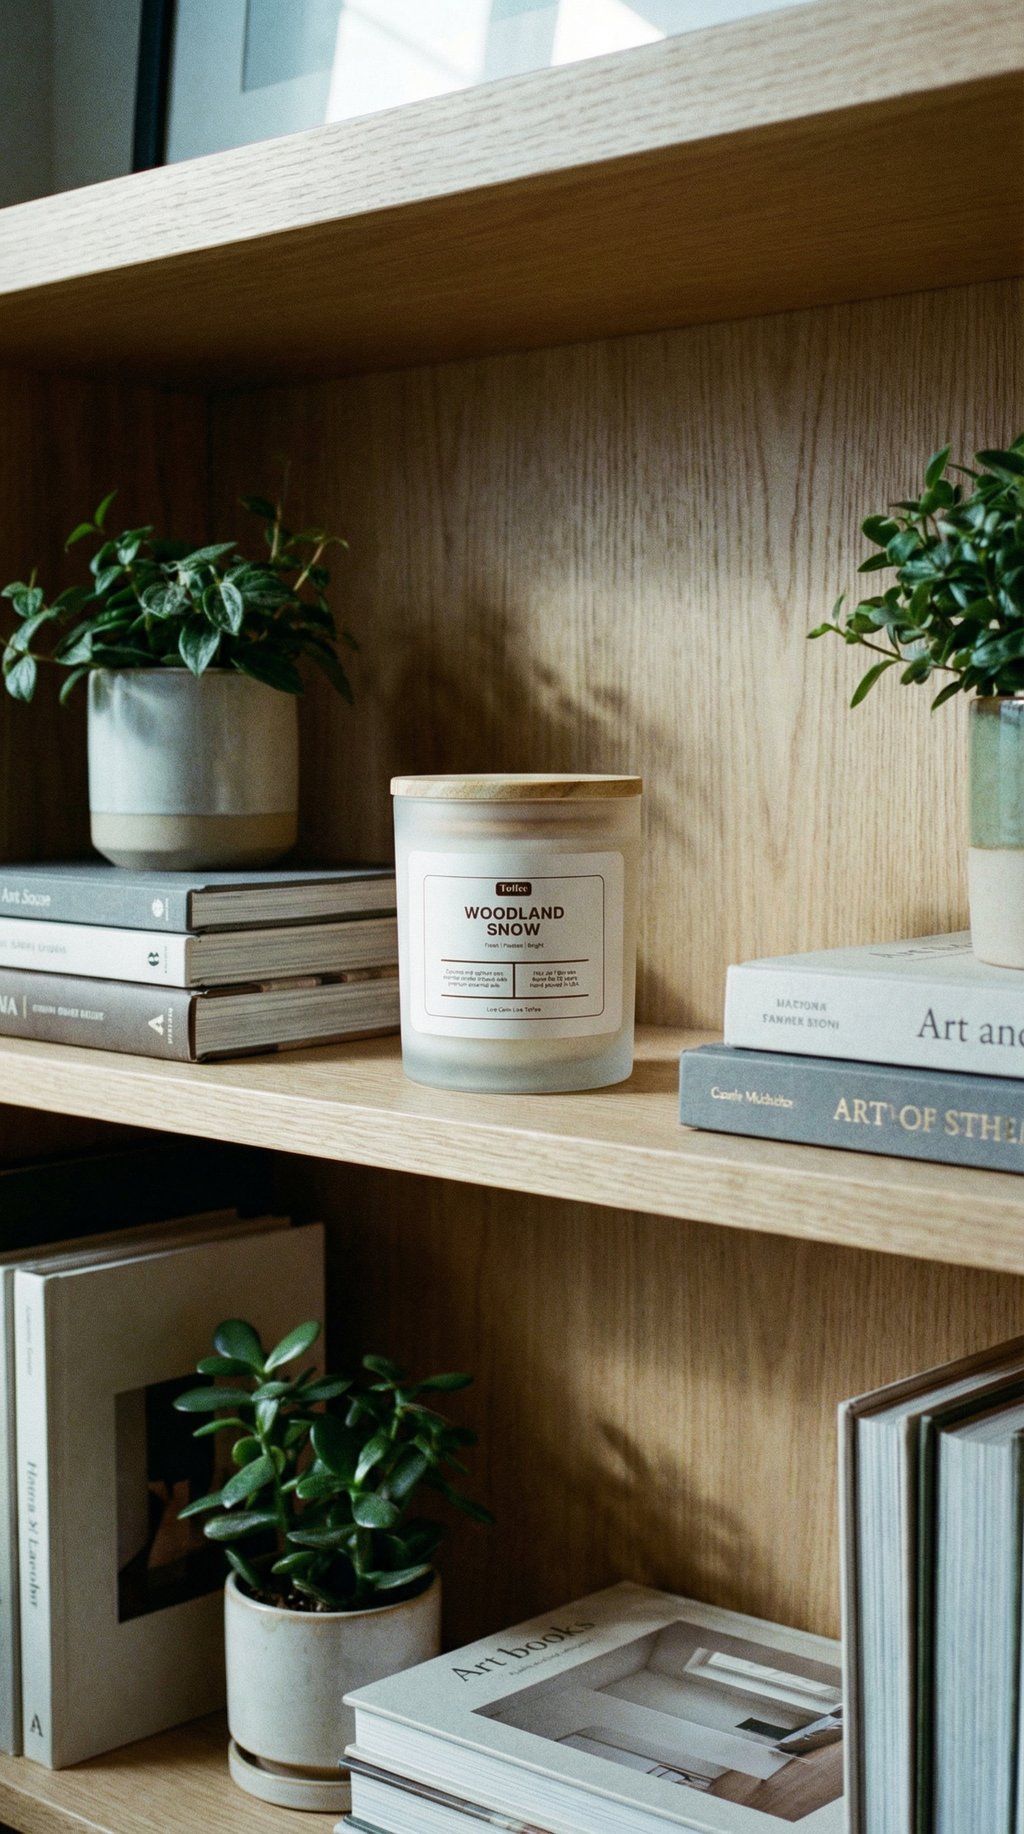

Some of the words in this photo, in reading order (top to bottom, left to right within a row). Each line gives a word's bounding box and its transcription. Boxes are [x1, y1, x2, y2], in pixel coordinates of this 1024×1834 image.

[1, 887, 20, 904] Art
[465, 906, 565, 920] WOODLAND
[487, 922, 540, 936] SNOW
[917, 1008, 967, 1042] Art
[833, 1097, 887, 1126] ART
[899, 1104, 937, 1132] OF
[451, 1655, 507, 1682] Art
[497, 1621, 596, 1659] books
